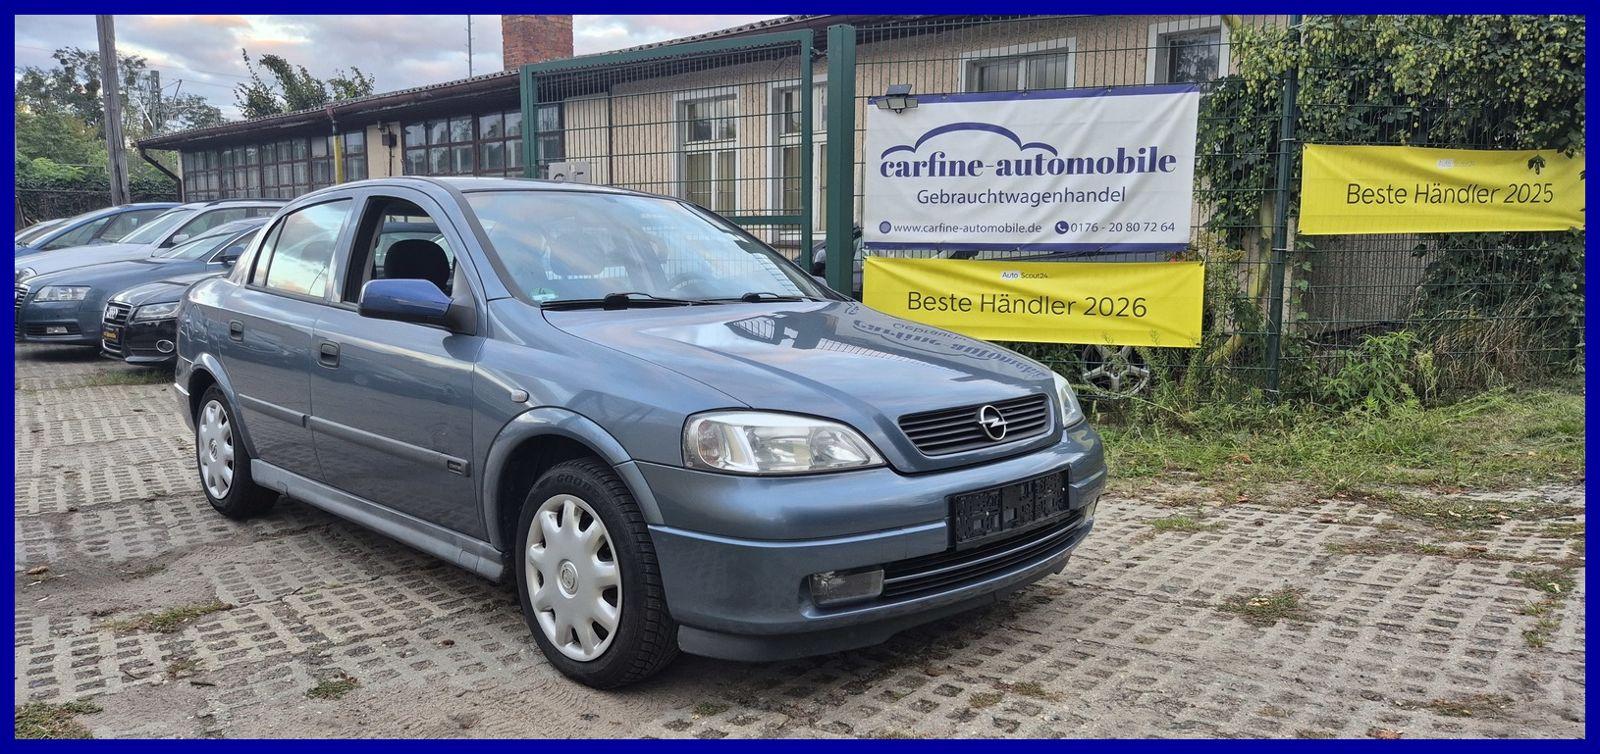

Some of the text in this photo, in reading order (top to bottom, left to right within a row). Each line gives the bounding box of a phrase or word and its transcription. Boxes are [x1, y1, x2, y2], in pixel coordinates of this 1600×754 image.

[880, 145, 1177, 178] carfine-automobile
[917, 186, 1126, 208] Gebrauchtwagenhandel
[1346, 182, 1554, 205] Beste Händler 2025
[893, 222, 1042, 234] www.carfine-automobile.de
[1070, 221, 1099, 233] 0176
[1108, 221, 1123, 233] 20
[1125, 221, 1141, 233] 80
[1143, 221, 1158, 232] 72
[1160, 221, 1175, 232] 64
[908, 291, 1148, 318] Beste Händler 2026
